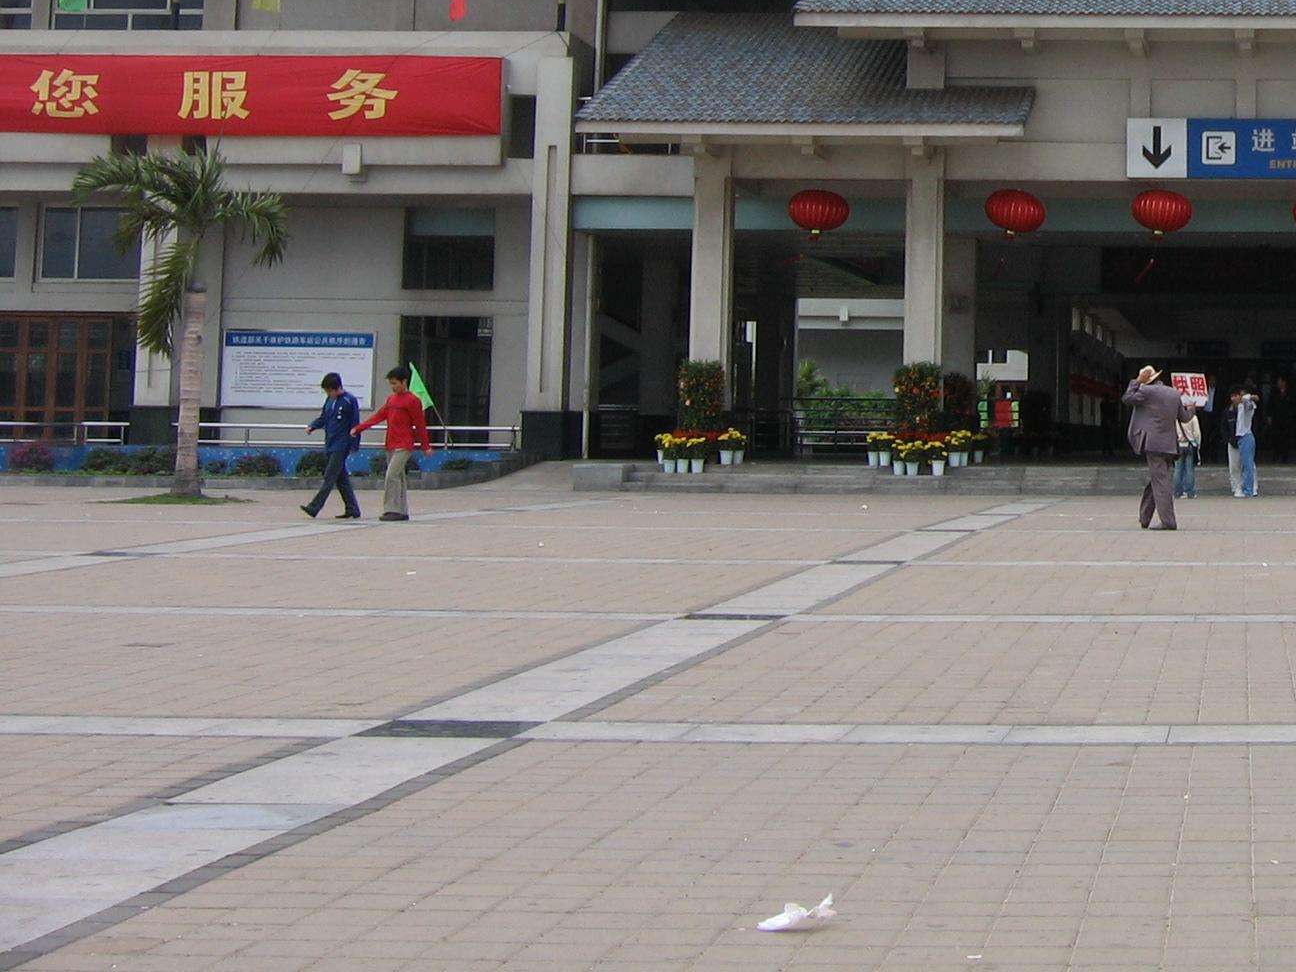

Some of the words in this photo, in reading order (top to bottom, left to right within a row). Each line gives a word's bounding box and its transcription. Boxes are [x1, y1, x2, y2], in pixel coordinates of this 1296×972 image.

[30, 68, 398, 120] 您服务
[1172, 375, 1207, 397] 快照
